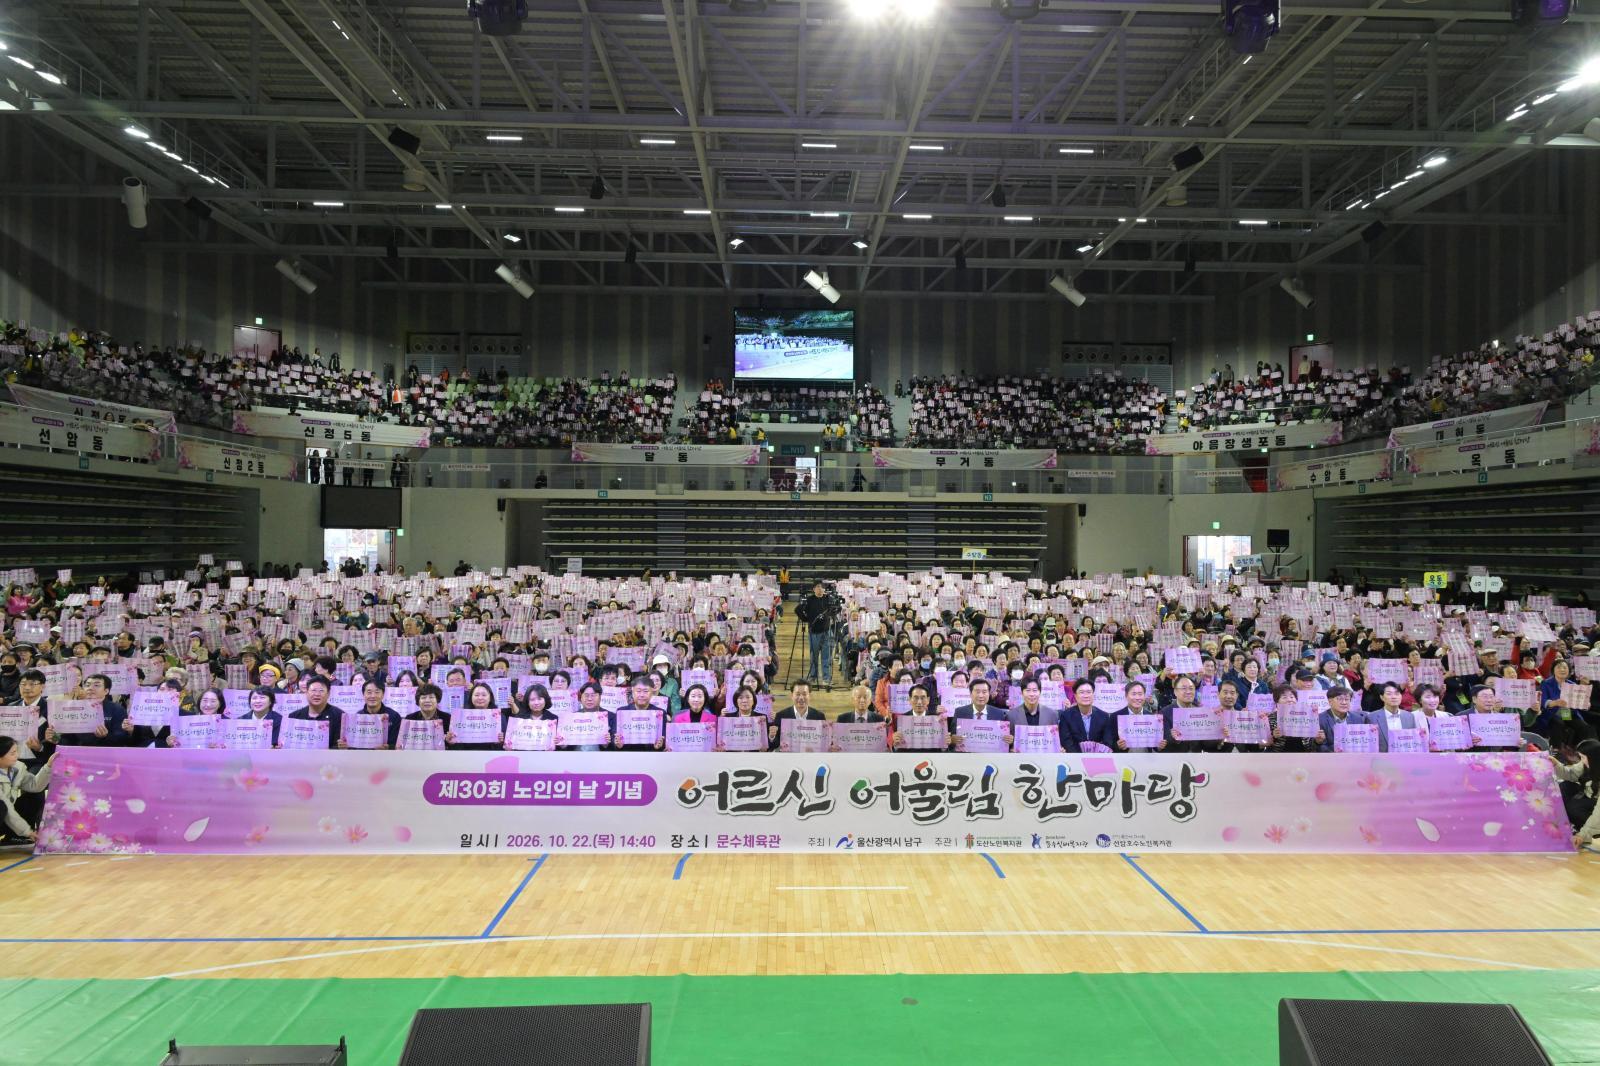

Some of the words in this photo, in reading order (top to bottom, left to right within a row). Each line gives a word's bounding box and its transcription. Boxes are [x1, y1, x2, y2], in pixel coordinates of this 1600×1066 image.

[438, 780, 507, 799] 제30회
[513, 780, 572, 799] 노인의
[579, 780, 599, 799] 날
[605, 780, 642, 799] 기념
[677, 765, 834, 820] 어르신
[850, 761, 1003, 825] 어울림
[1014, 763, 1209, 822] 한마당
[507, 834, 544, 848] 2026.
[549, 834, 568, 848] 10.
[572, 834, 615, 849] 22.(목)
[620, 835, 656, 848] 14:40
[717, 834, 782, 849] 문수체육관
[856, 837, 901, 848] 울산광역시
[905, 837, 923, 847] 남구
[935, 837, 952, 847] 주관
[976, 839, 1022, 849] 도산노인복지관
